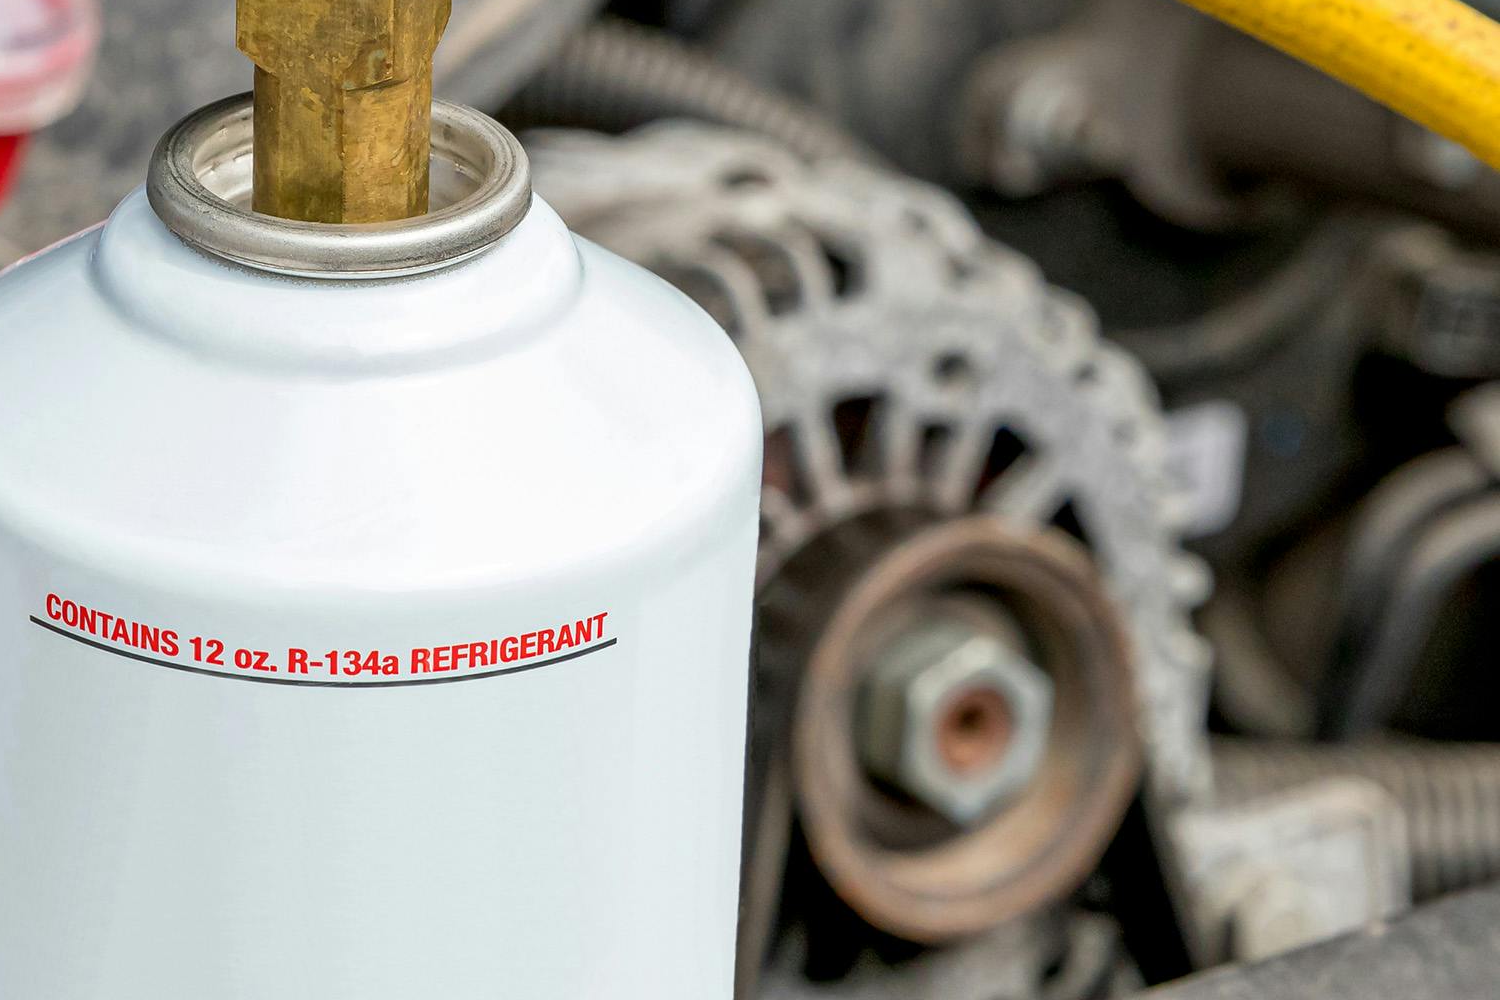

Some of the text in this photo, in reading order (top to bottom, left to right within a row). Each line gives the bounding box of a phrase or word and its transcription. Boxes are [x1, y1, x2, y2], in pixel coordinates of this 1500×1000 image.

[45, 593, 609, 676] CONTAINS 12 oz. R-134a REFRIGERANT
